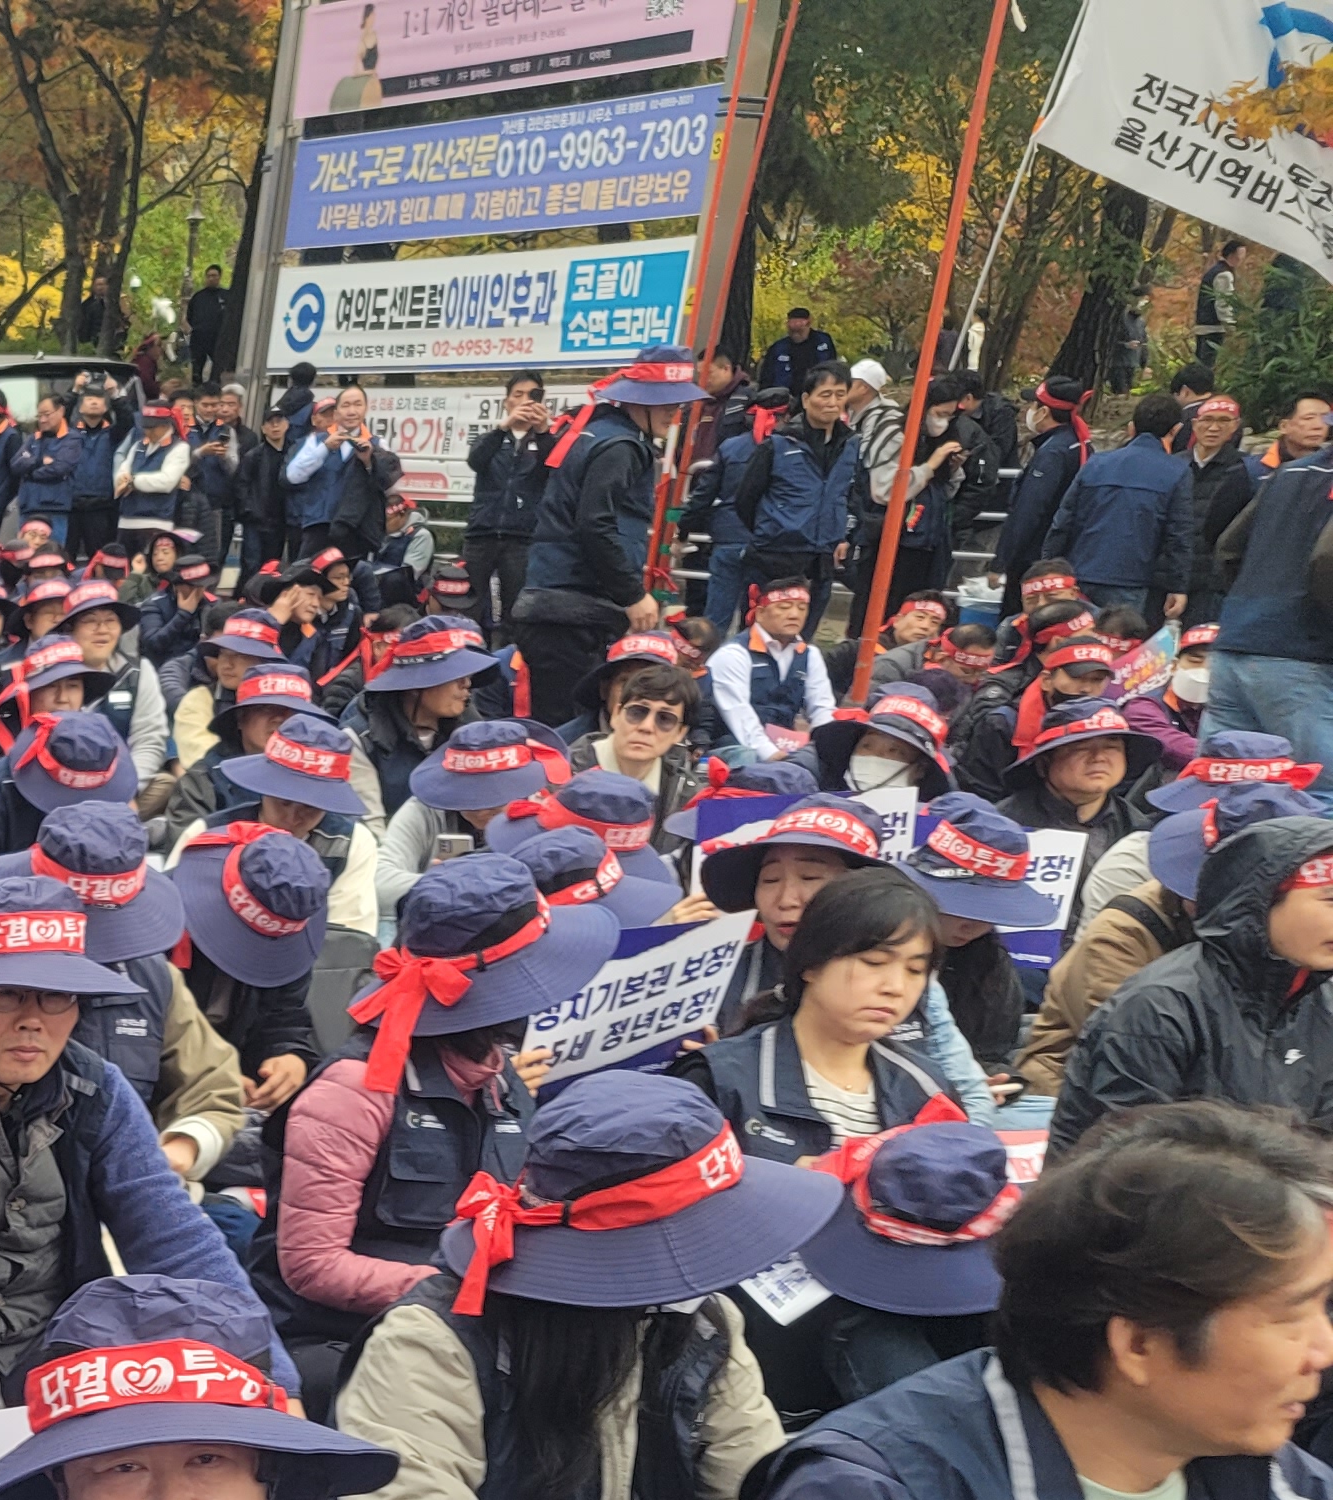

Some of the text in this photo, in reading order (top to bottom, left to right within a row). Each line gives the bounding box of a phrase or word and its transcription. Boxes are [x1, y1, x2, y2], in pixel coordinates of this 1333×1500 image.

[437, 0, 475, 33] 개인
[309, 112, 709, 193] 가산.구로 지산전문 010-9963-7303
[713, 137, 722, 155] 3
[470, 183, 540, 221] 저렴하고
[570, 260, 644, 302] 코골이
[343, 338, 534, 360] 여의도역 4번출구 02-6953-7542
[972, 846, 1017, 878] 투쟁
[676, 941, 735, 988] 보장!
[600, 984, 722, 1052] 정년연장!
[696, 1131, 742, 1189] 단결
[39, 1347, 263, 1418] 단결 투쟁
